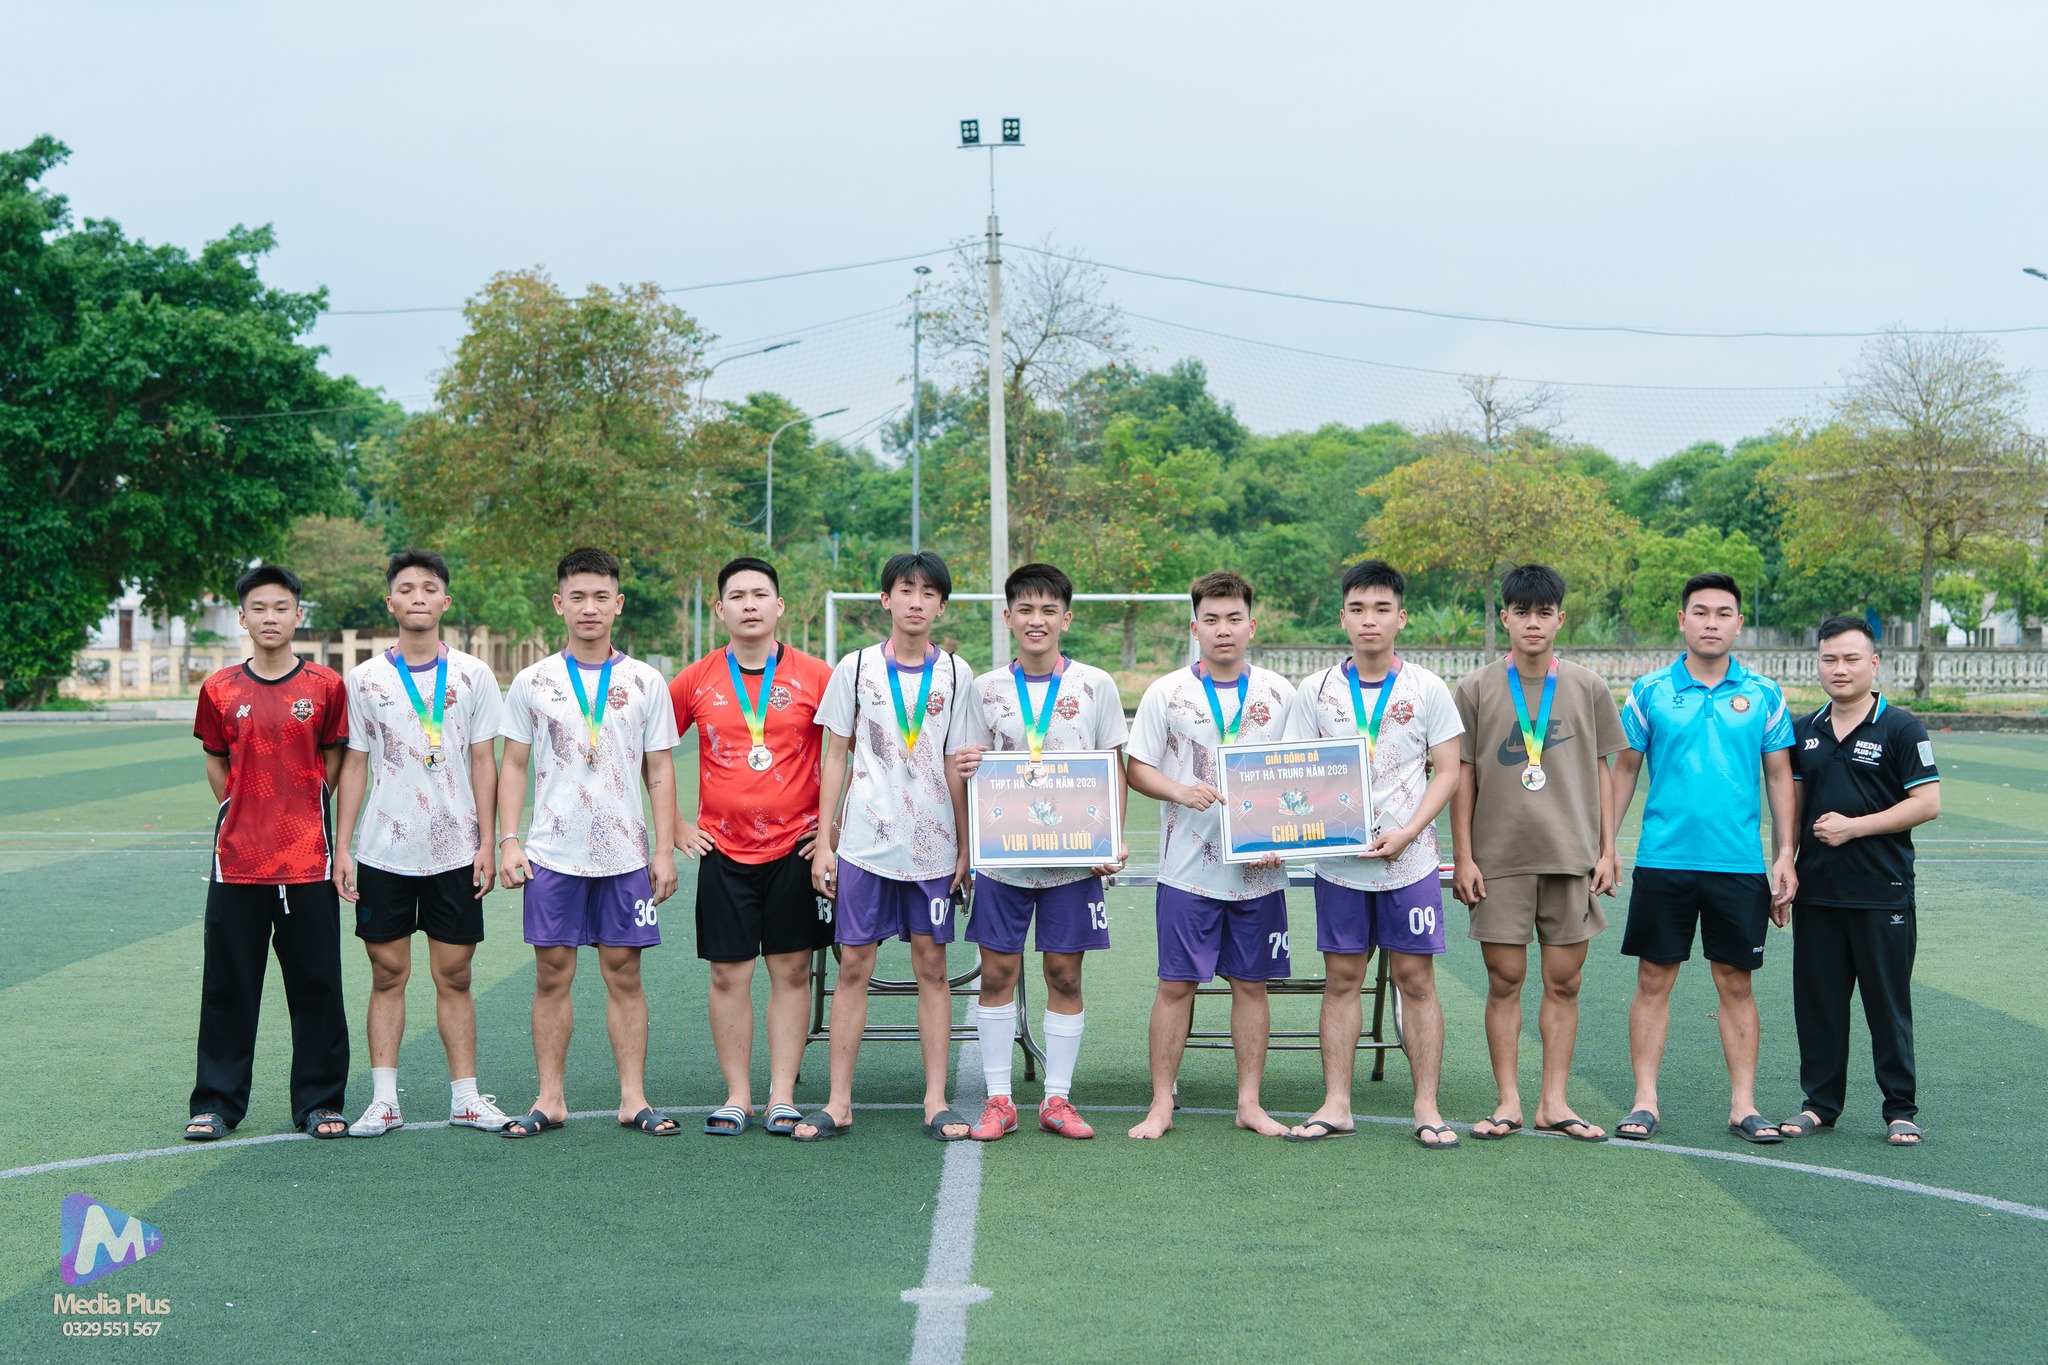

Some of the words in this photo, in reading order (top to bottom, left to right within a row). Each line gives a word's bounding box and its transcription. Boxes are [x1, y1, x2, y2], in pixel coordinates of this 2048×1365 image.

[1855, 740, 1883, 752] MEDIA
[1265, 752, 1282, 765] GIẢI
[1283, 751, 1306, 764] BÓNG
[1307, 750, 1320, 763] ĐÁ
[1057, 762, 1069, 774] ĐÁ
[1239, 770, 1261, 782] THPT
[1263, 767, 1275, 781] HÀ
[1277, 767, 1304, 780] TRUNG
[1306, 764, 1325, 778] NĂM
[1327, 764, 1348, 776] 2026
[990, 779, 1012, 790] THPT
[1014, 777, 1025, 790] HÀ
[1056, 775, 1074, 789] NĂM
[1076, 777, 1097, 788] 2026
[1002, 833, 1028, 851] VUA
[1032, 831, 1059, 851] PHÁ
[1271, 821, 1299, 843] GIẢI
[634, 898, 658, 927] 36
[1087, 901, 1108, 930] 13
[1408, 905, 1436, 935] 09
[1268, 931, 1290, 959] 79
